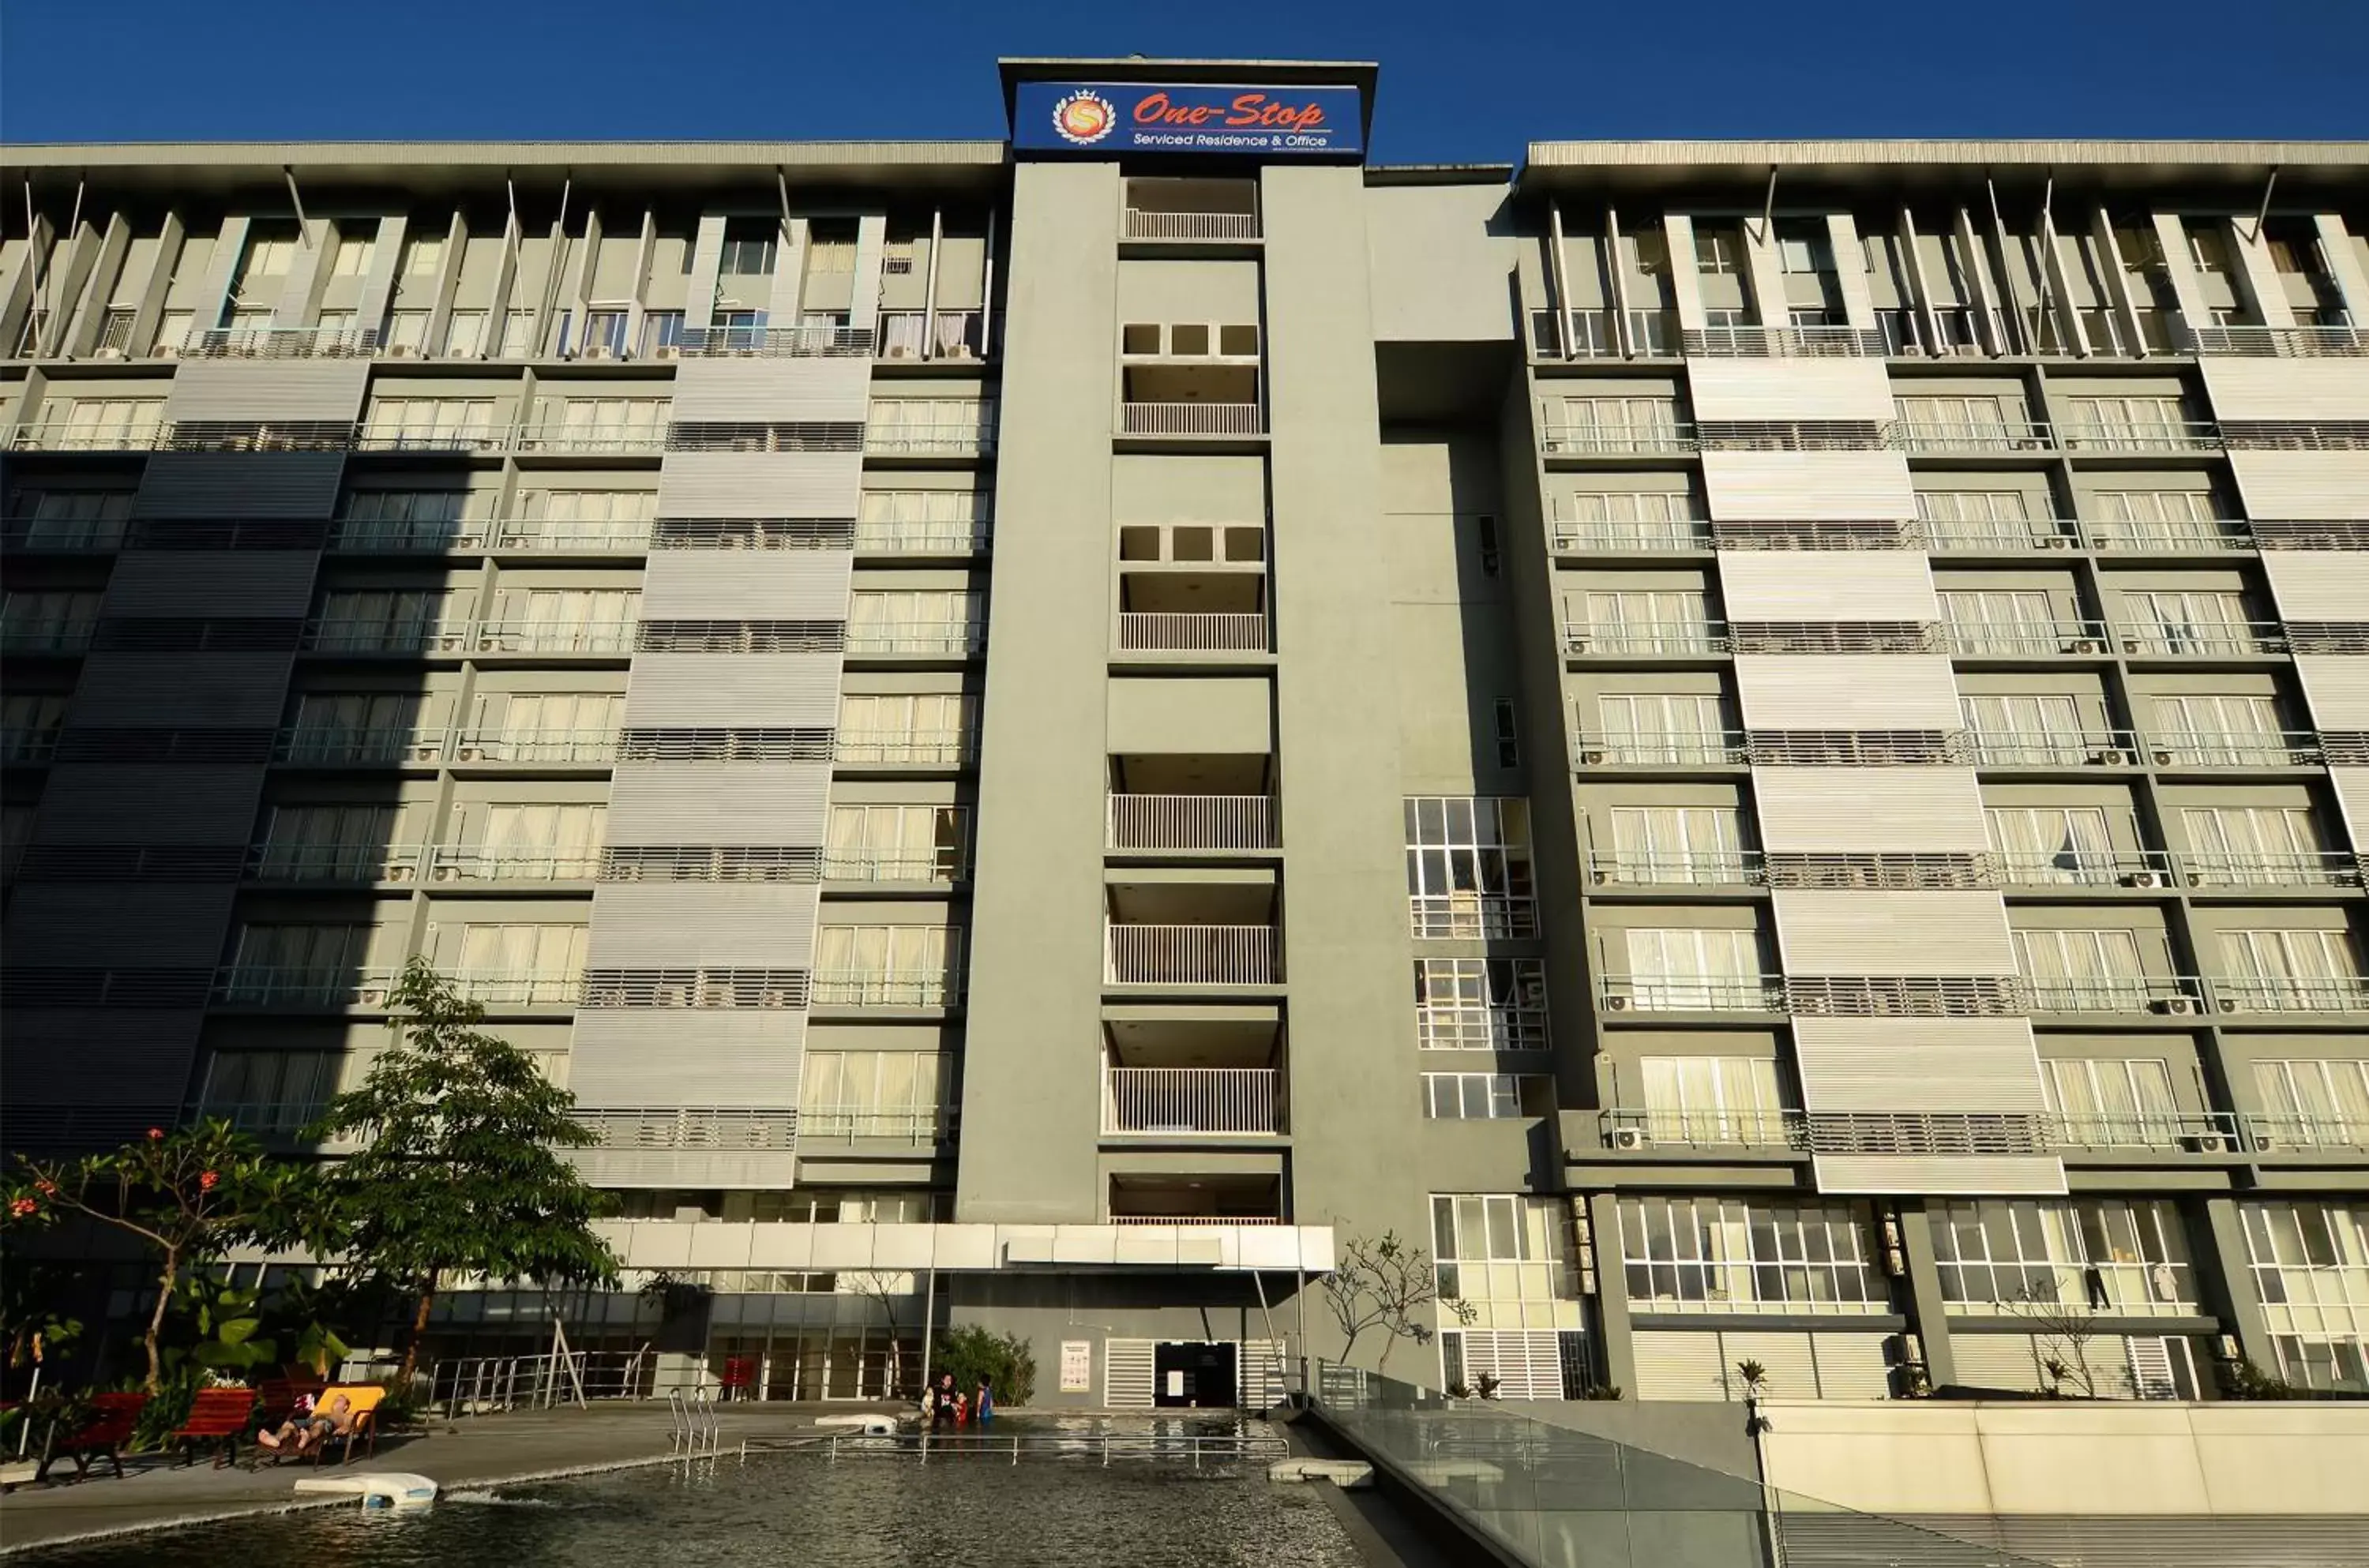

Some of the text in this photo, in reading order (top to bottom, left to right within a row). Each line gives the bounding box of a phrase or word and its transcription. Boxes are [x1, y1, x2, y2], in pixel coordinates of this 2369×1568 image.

[1134, 92, 1325, 133] One-Stop
[1134, 133, 1327, 146] Serviced Residence & Office
